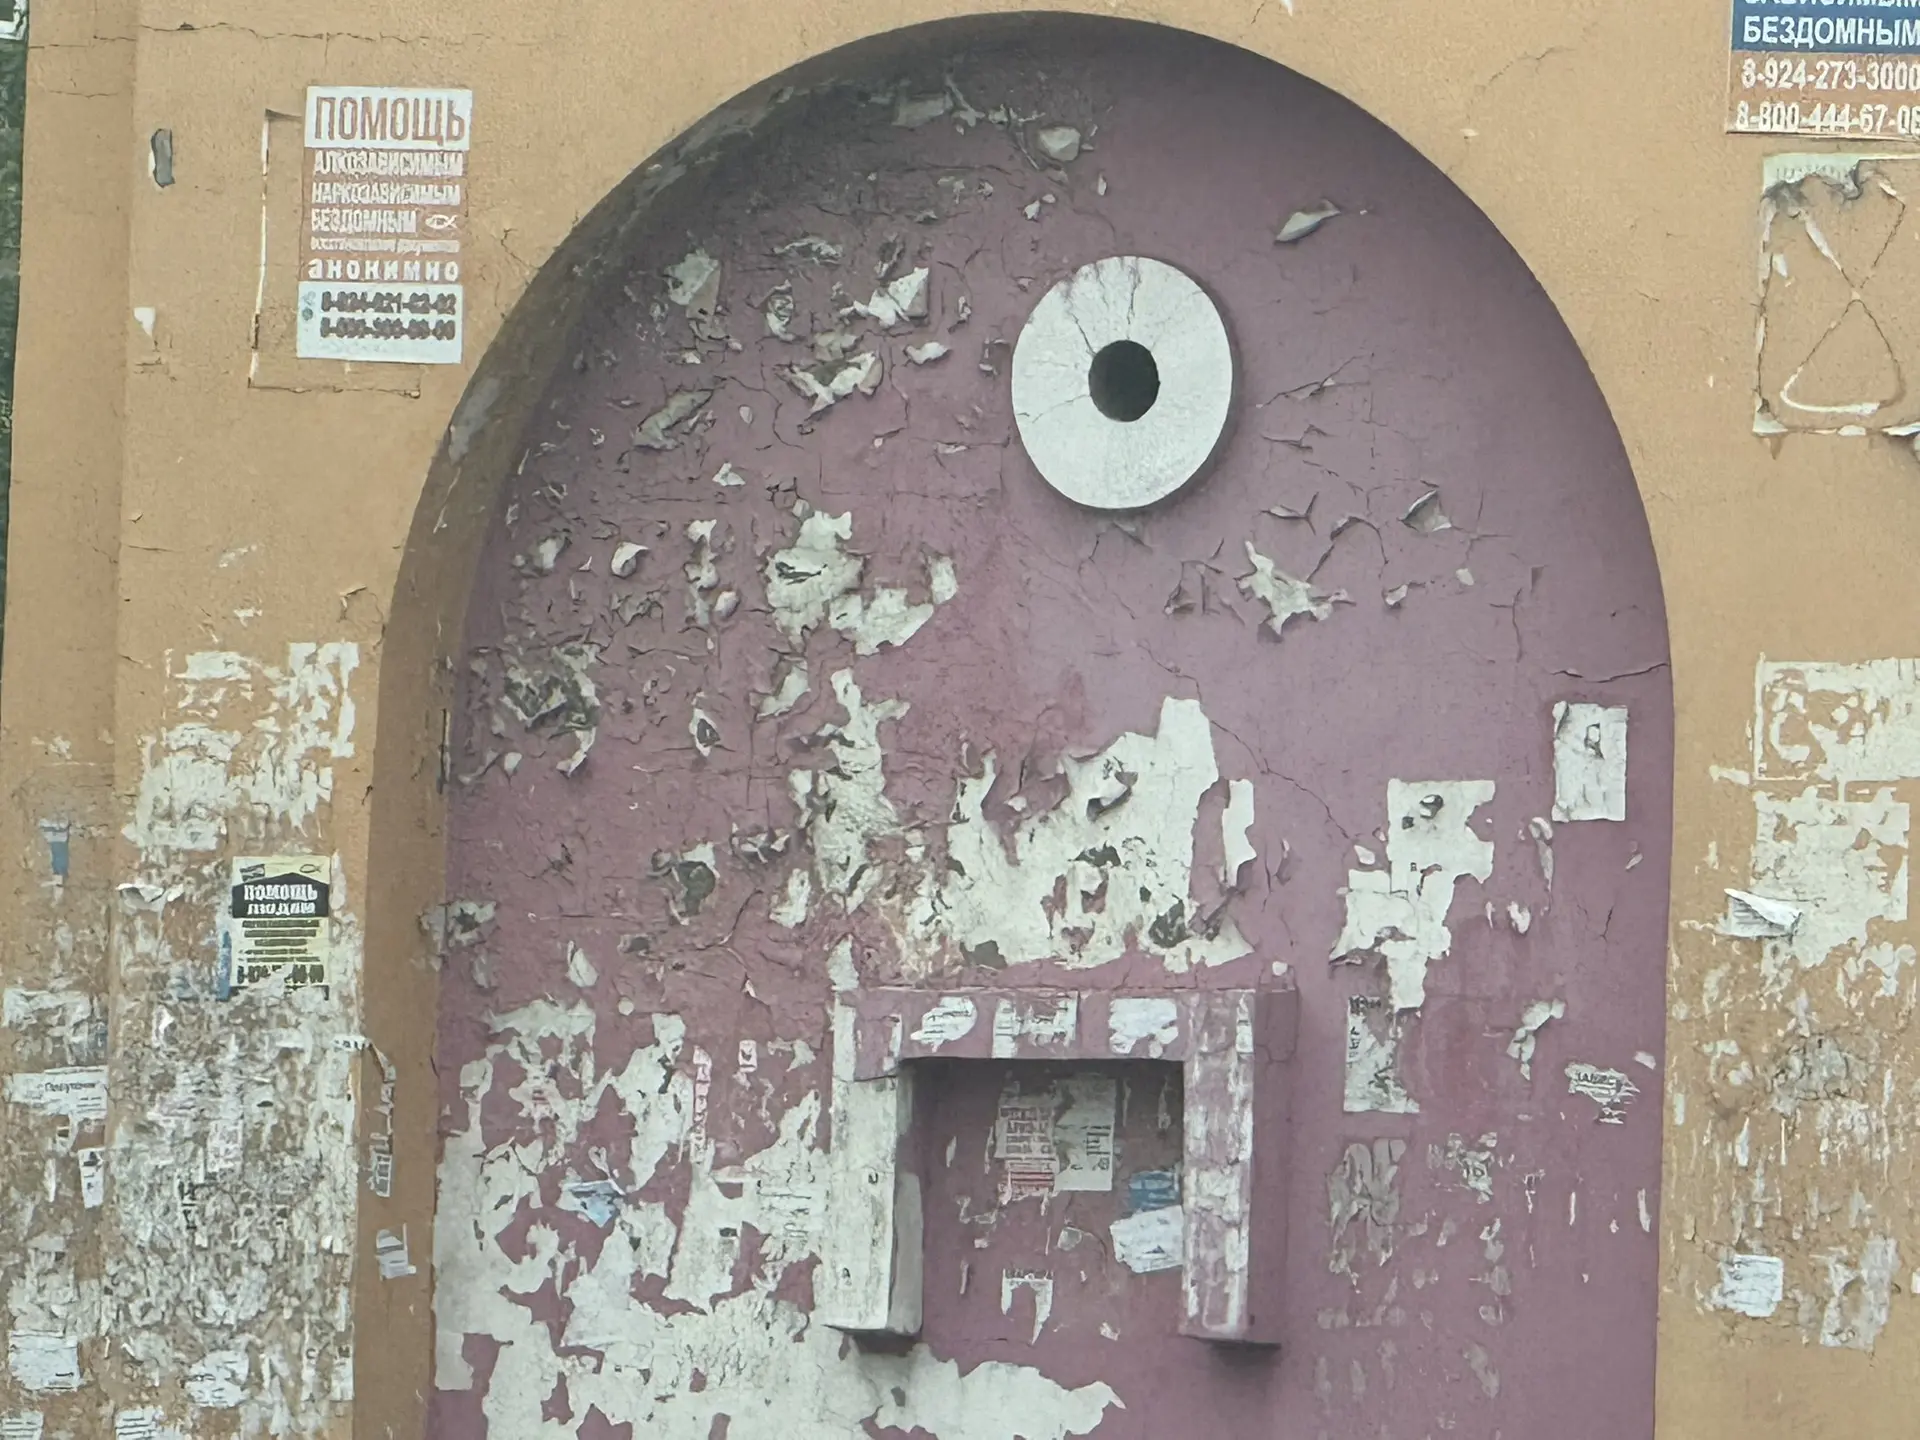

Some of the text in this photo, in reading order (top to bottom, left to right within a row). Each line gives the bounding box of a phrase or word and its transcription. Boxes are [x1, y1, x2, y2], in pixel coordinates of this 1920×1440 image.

[1743, 16, 1920, 48] БЕЗДОМНЫМ
[1741, 57, 1920, 91] 8-924-273-3000
[314, 96, 465, 145] ПОМОЩЬ
